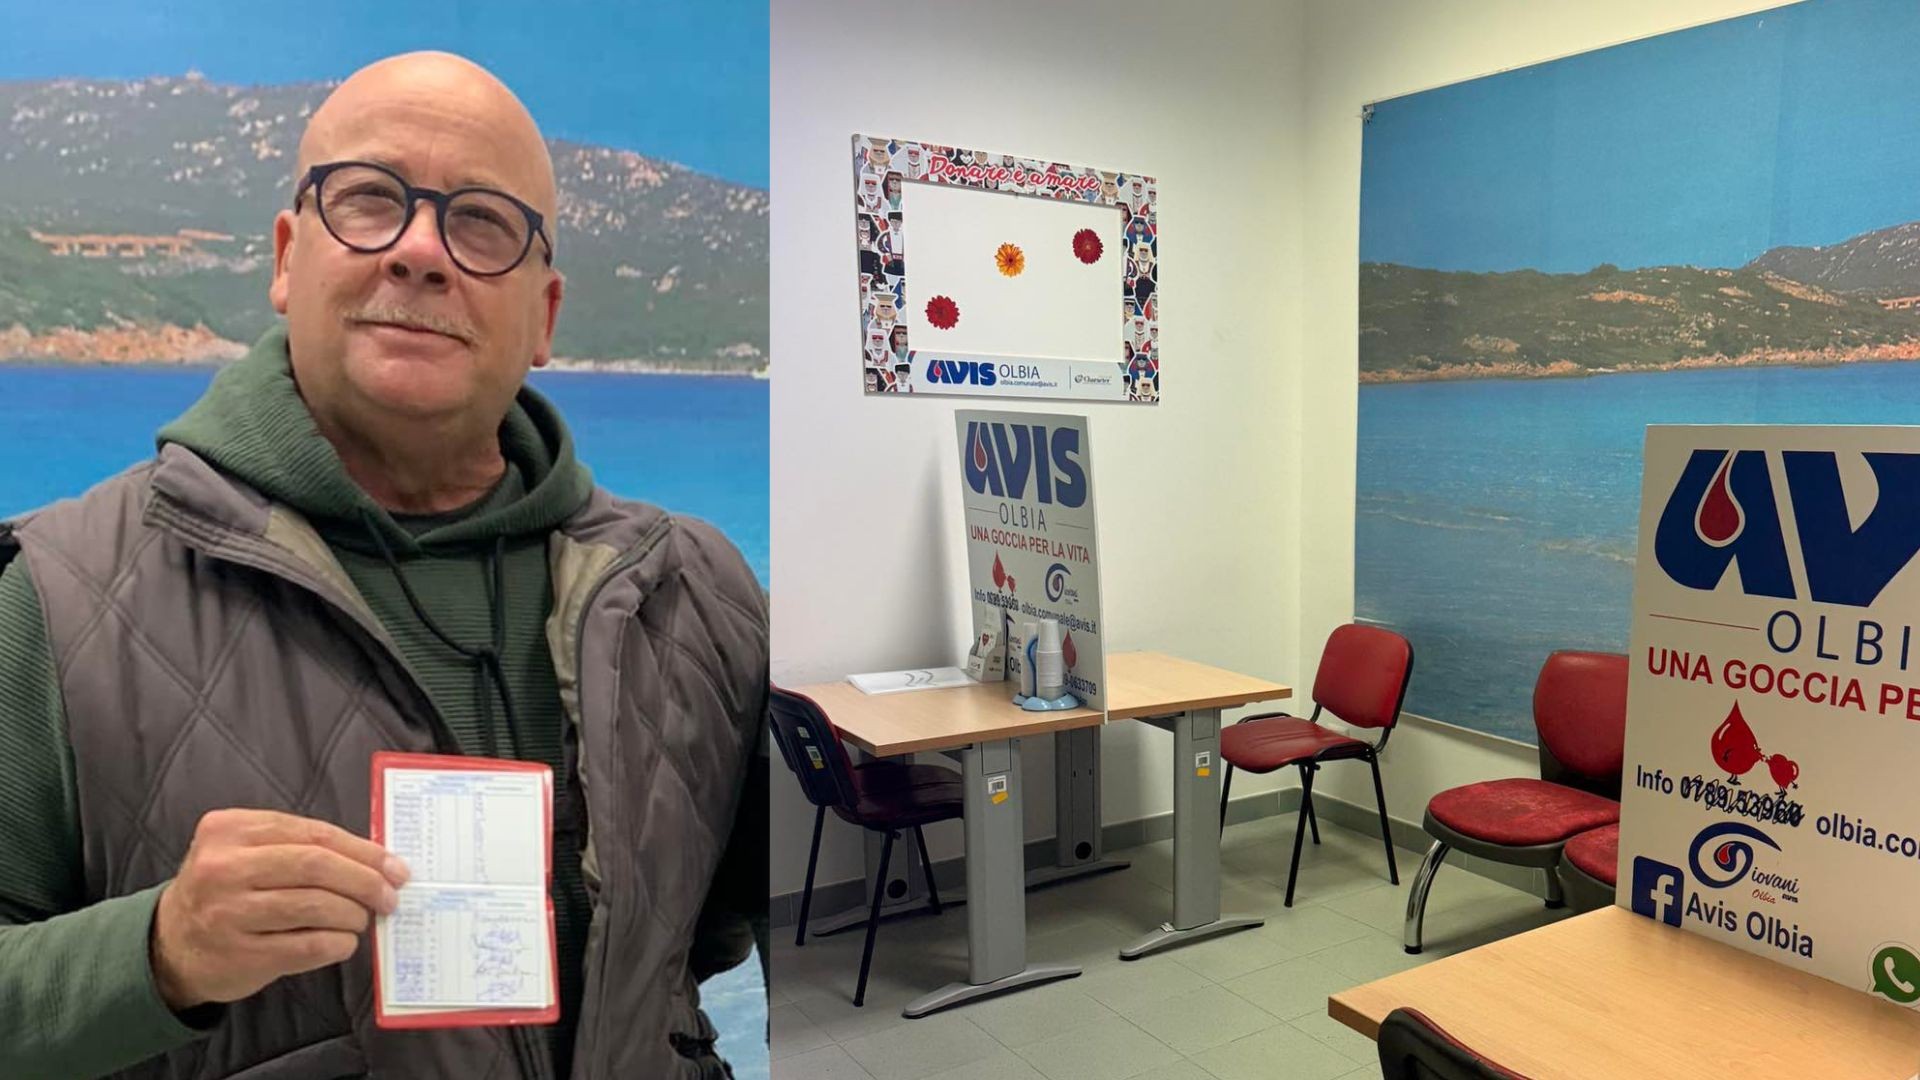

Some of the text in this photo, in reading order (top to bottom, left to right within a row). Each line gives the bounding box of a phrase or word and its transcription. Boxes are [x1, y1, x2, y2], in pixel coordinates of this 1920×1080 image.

[930, 155, 1100, 191] Donare è amare
[926, 360, 996, 386] AVIS
[1000, 363, 1041, 380] OLBIA
[965, 421, 1087, 508] AVIS
[999, 502, 1047, 532] OLBIA
[970, 524, 1091, 564] UNA GOCCIA PER LA VITA
[1767, 610, 1911, 671] OLBI
[1648, 646, 1713, 684] UNA
[1723, 659, 1866, 711] GOCCIA
[1636, 764, 1673, 795] Info
[1816, 812, 1920, 860] olbia.co
[1686, 891, 1737, 932] Avis
[1747, 911, 1813, 959] Olbia
